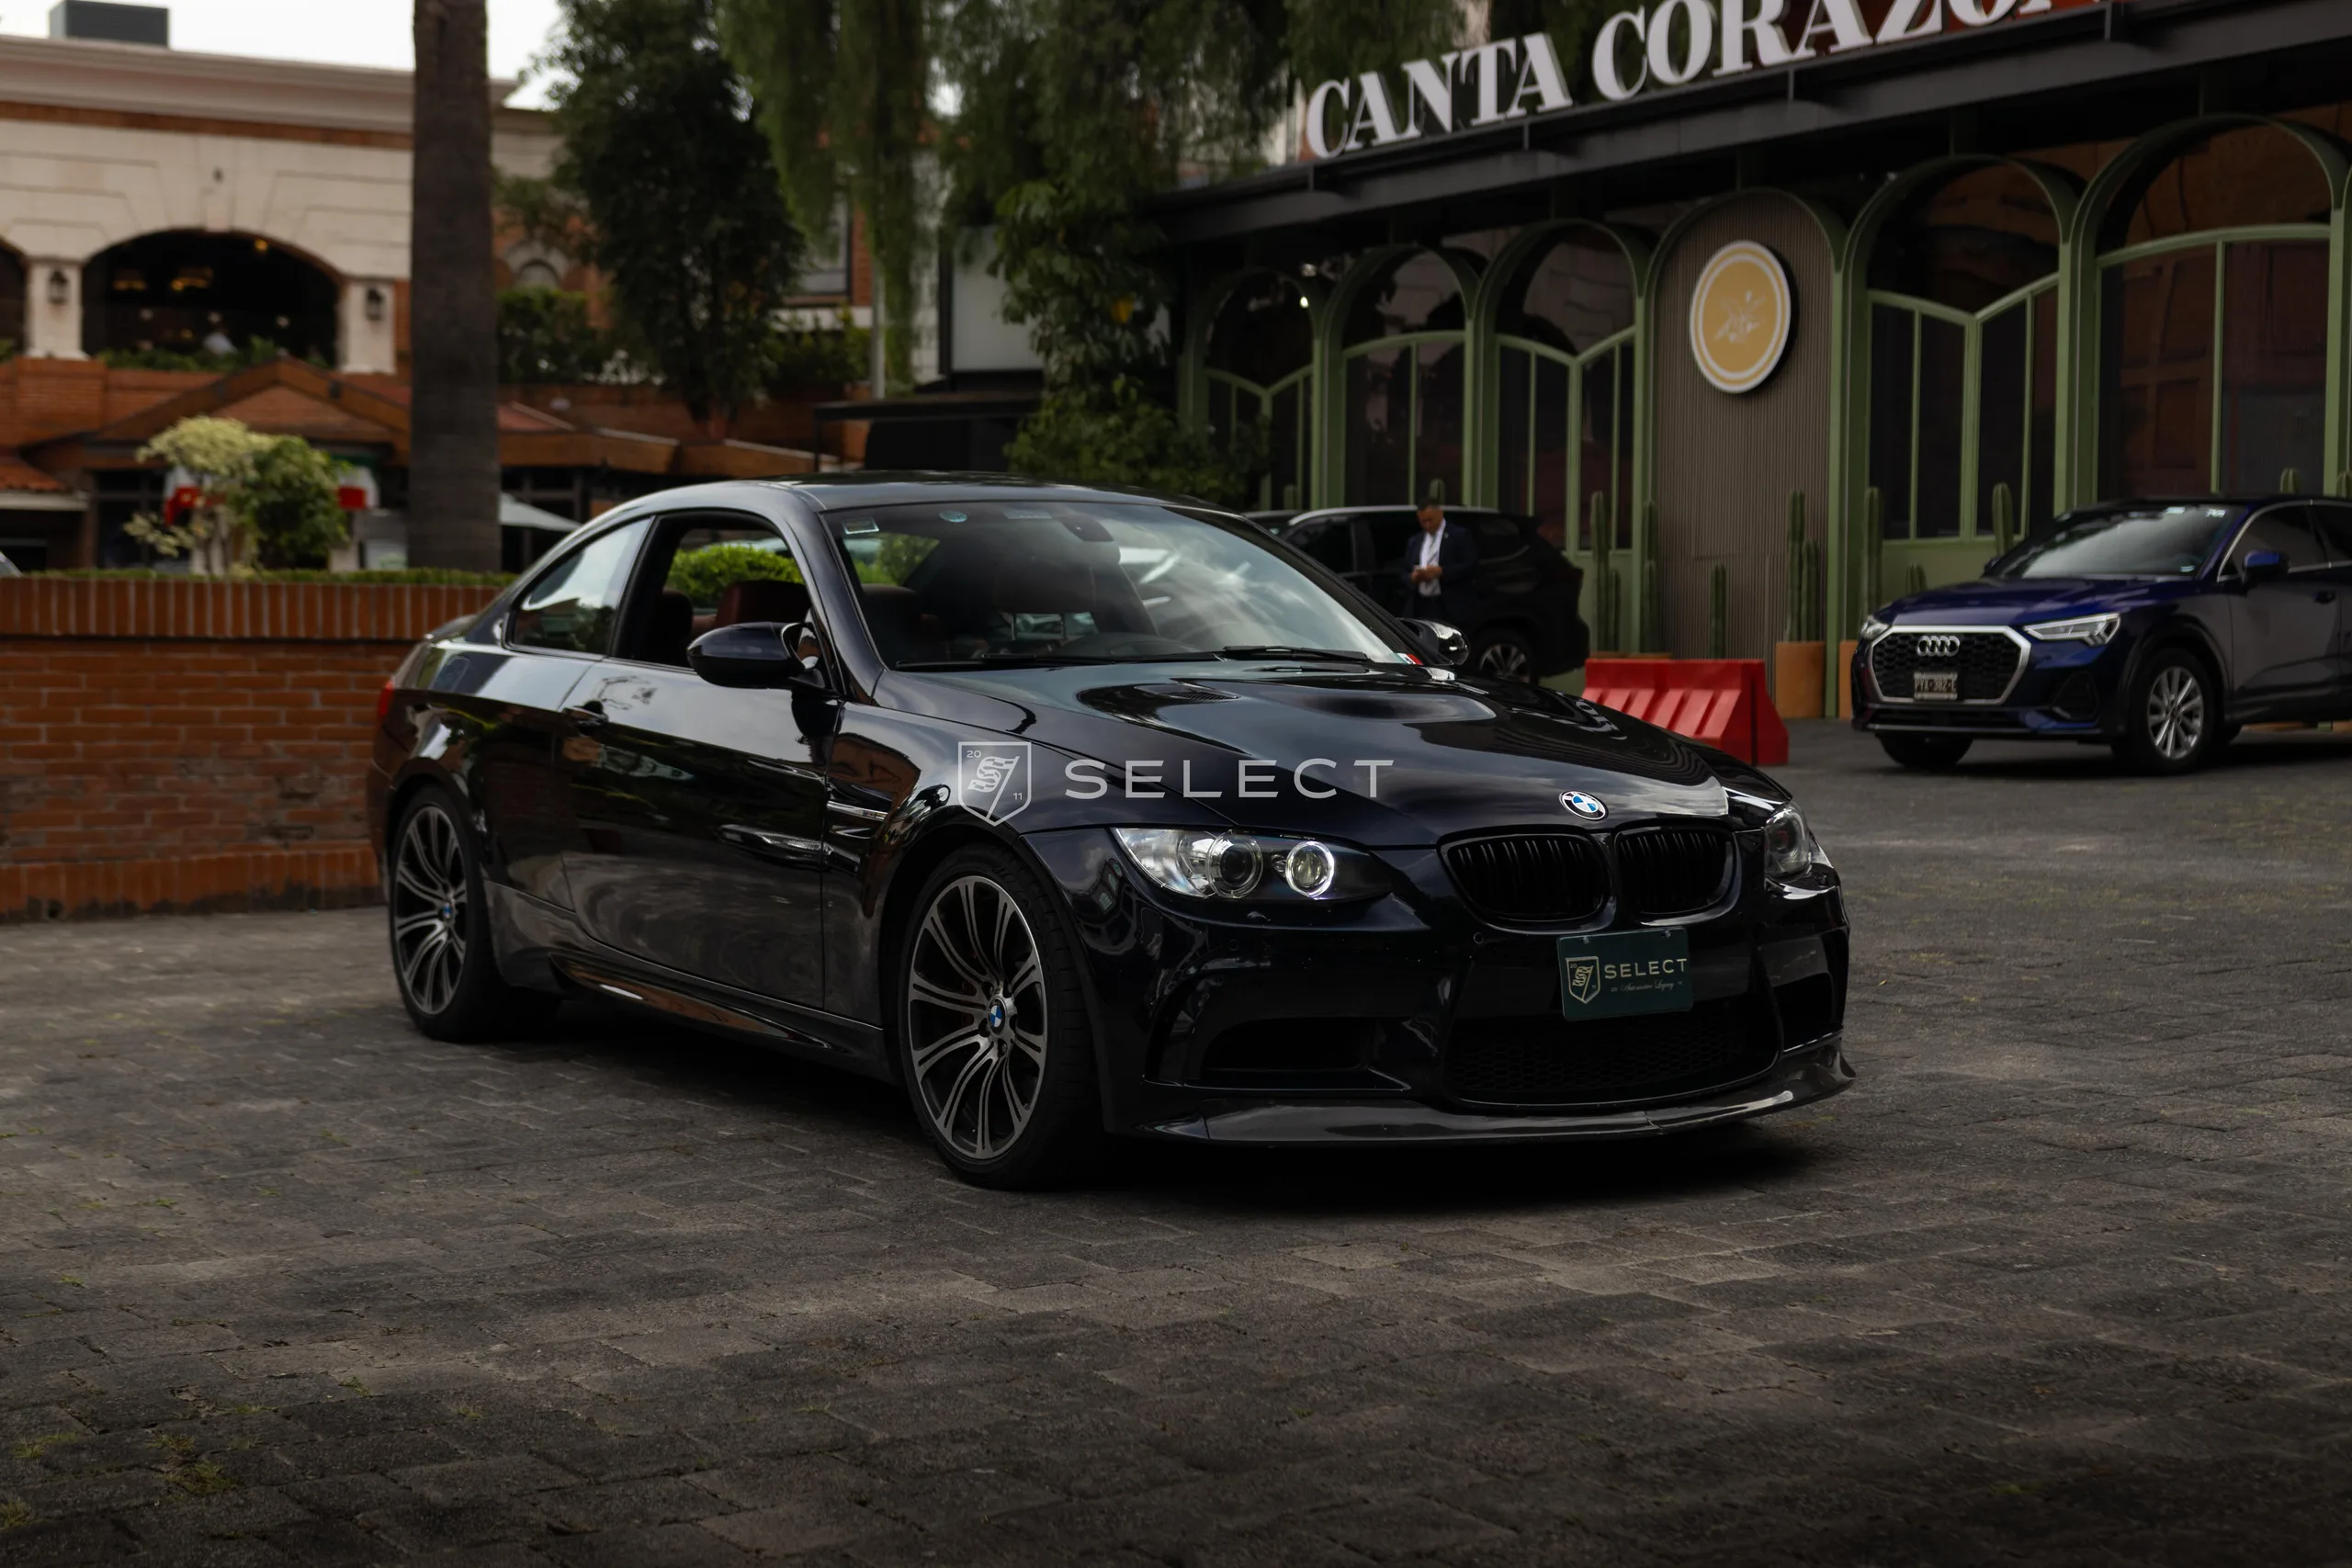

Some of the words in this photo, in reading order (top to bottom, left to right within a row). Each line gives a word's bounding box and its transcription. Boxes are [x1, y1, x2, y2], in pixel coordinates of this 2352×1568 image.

[1306, 33, 1573, 160] CANTA
[1592, 0, 2100, 100] CORA
[1604, 958, 1688, 979] SELECT
